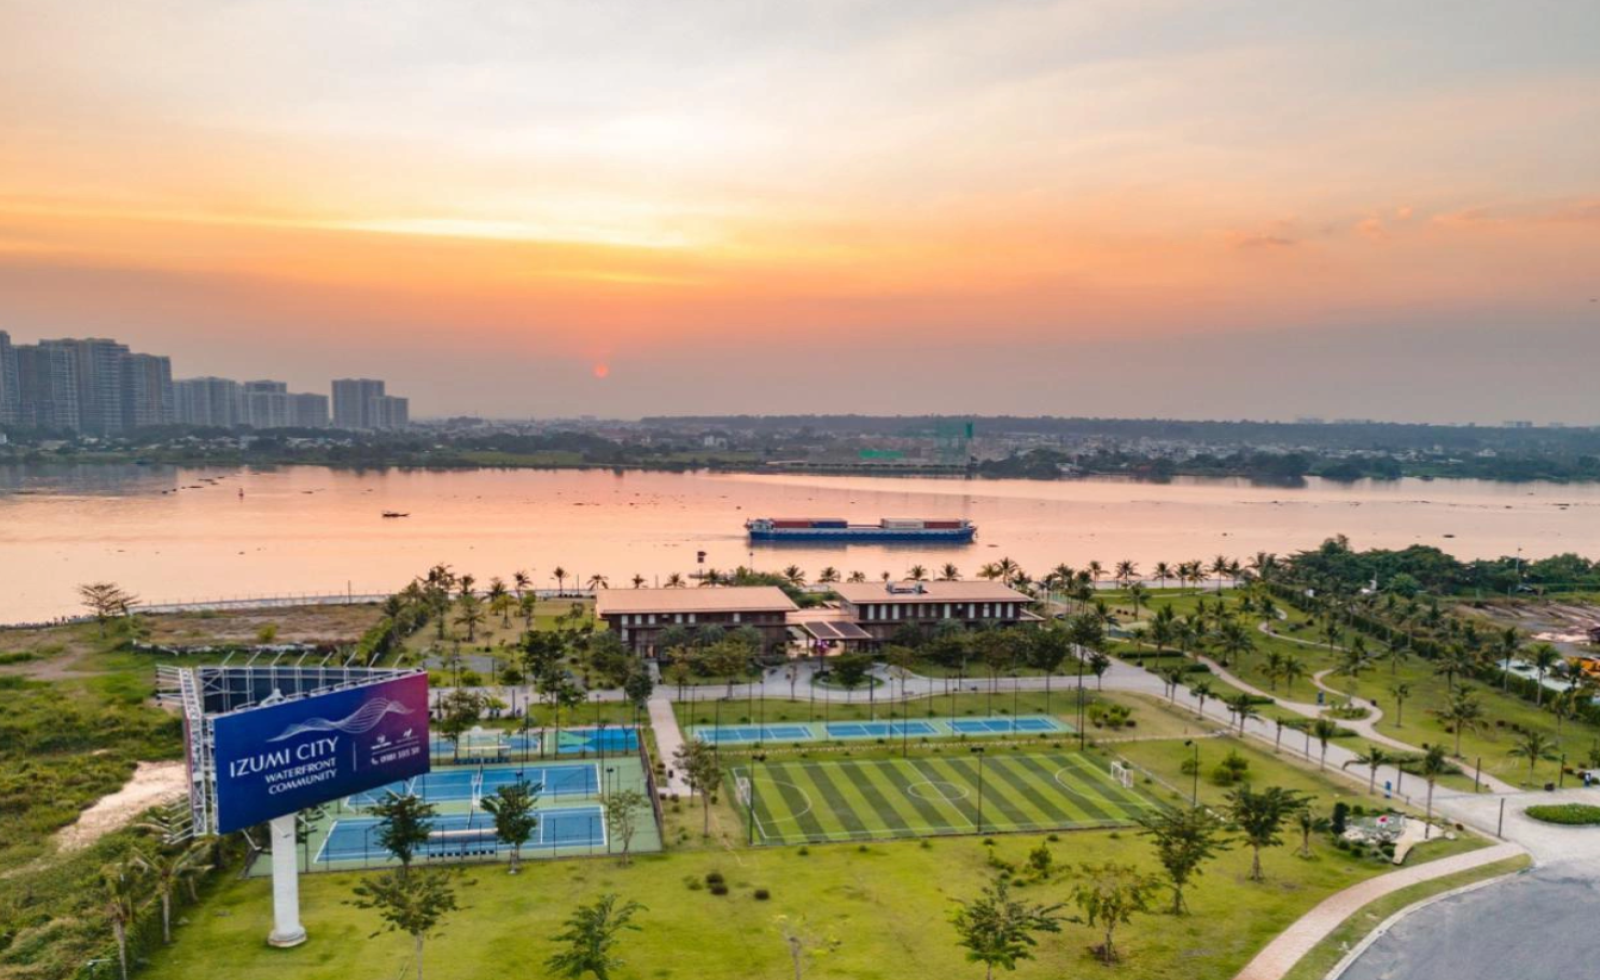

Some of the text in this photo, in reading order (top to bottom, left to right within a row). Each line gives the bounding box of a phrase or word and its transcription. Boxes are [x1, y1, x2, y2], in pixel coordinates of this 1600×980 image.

[229, 736, 339, 778] IZUMI CITY
[265, 757, 336, 784] WATERFRONT
[268, 769, 337, 795] COMMUNITY
